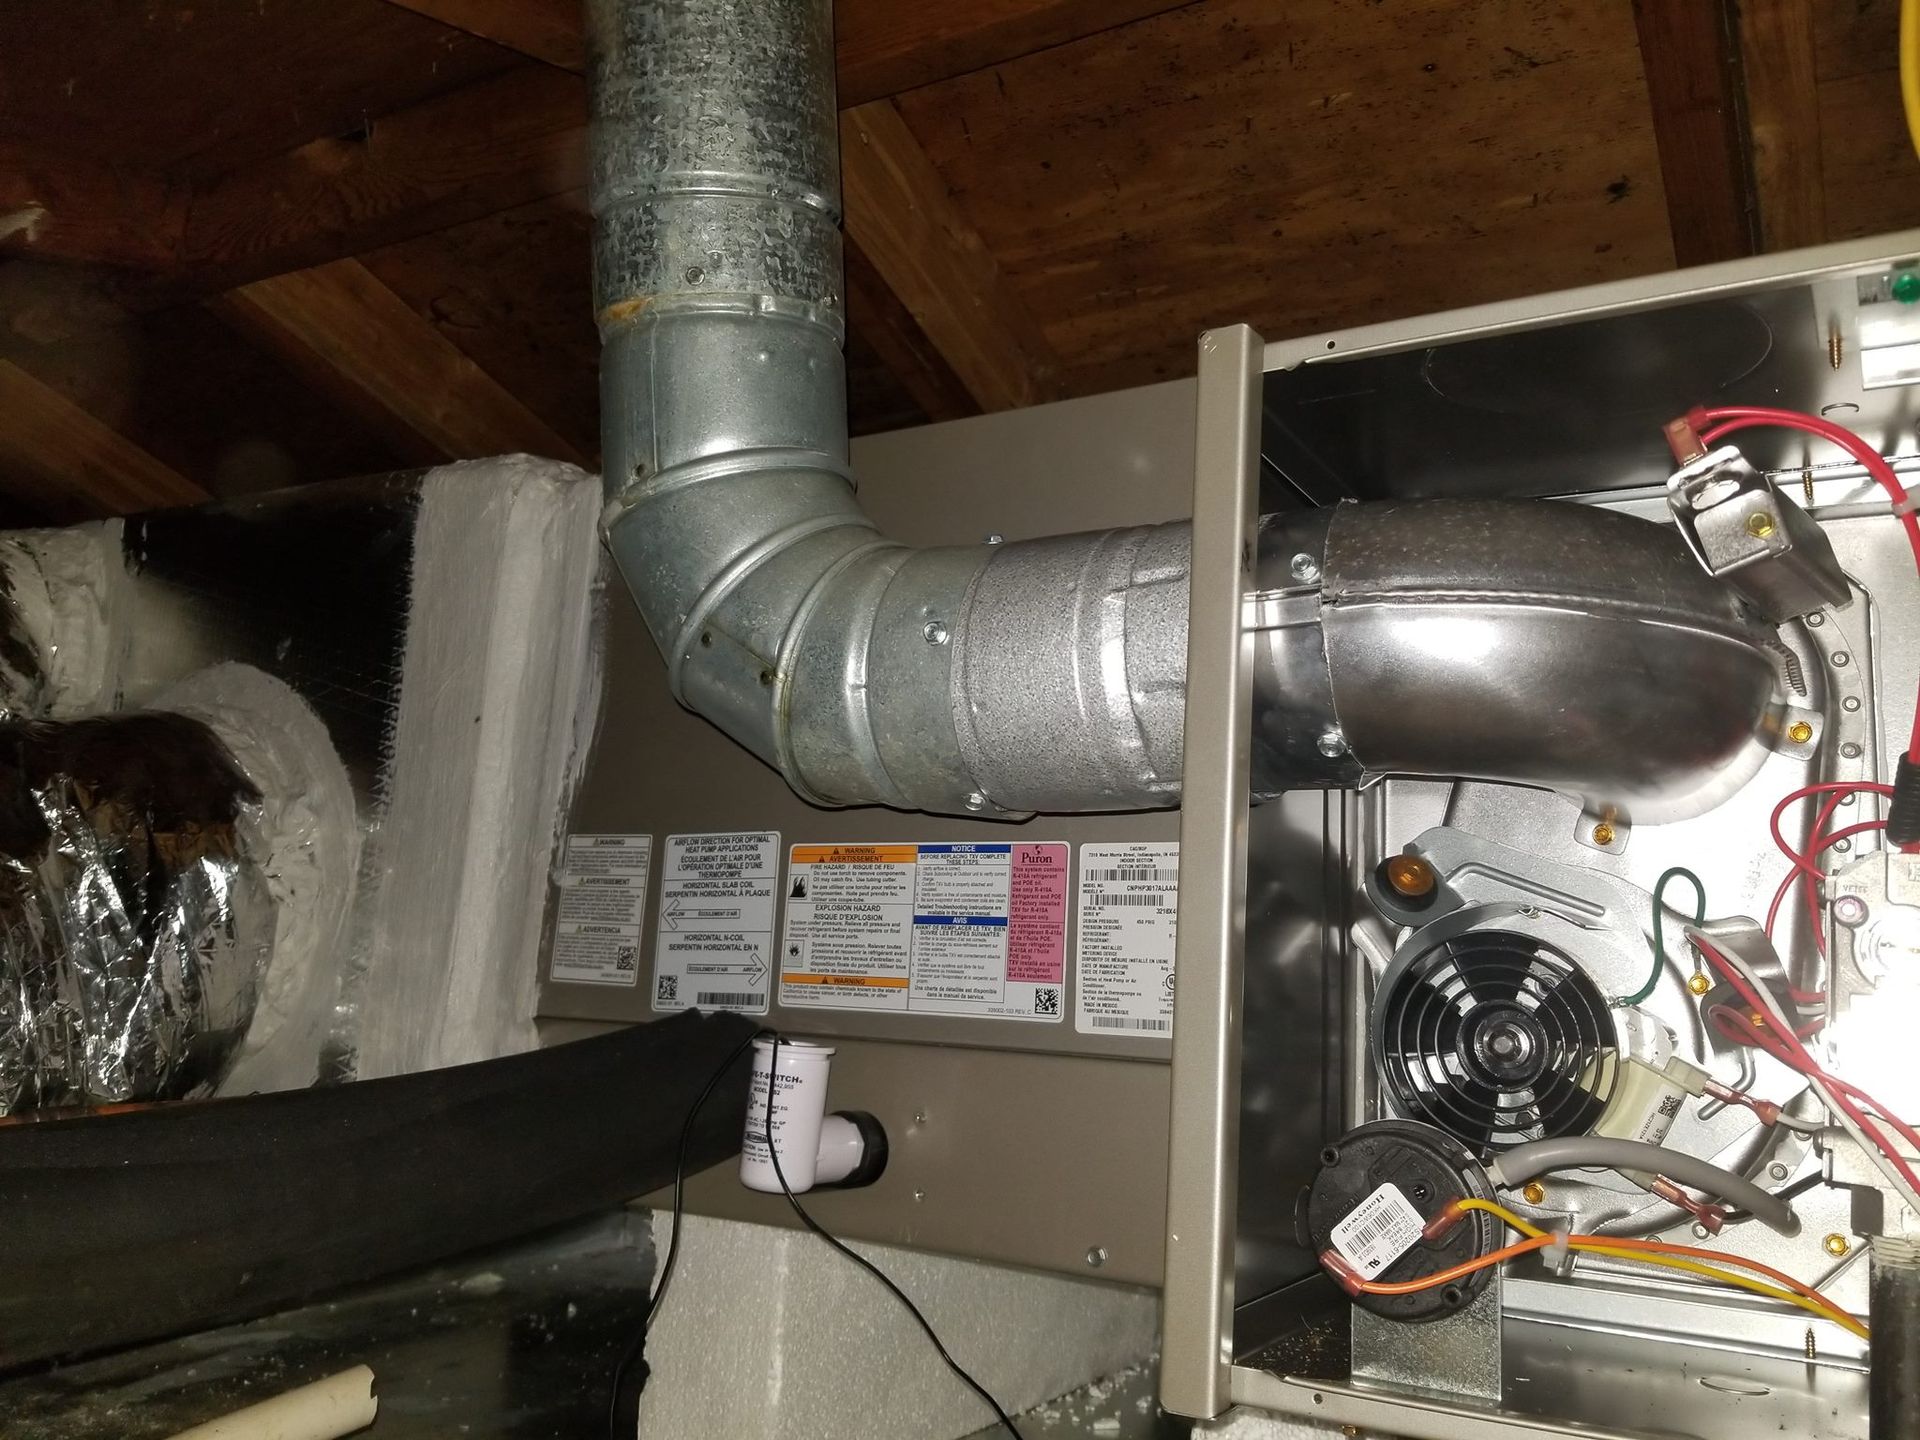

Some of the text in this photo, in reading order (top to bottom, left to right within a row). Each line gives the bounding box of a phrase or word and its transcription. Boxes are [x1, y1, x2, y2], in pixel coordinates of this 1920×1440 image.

[1022, 852, 1052, 863] Puron
[834, 977, 866, 985] WARNING
[1341, 1194, 1384, 1233] Honeywell
[1389, 1233, 1403, 1246] FIRE
